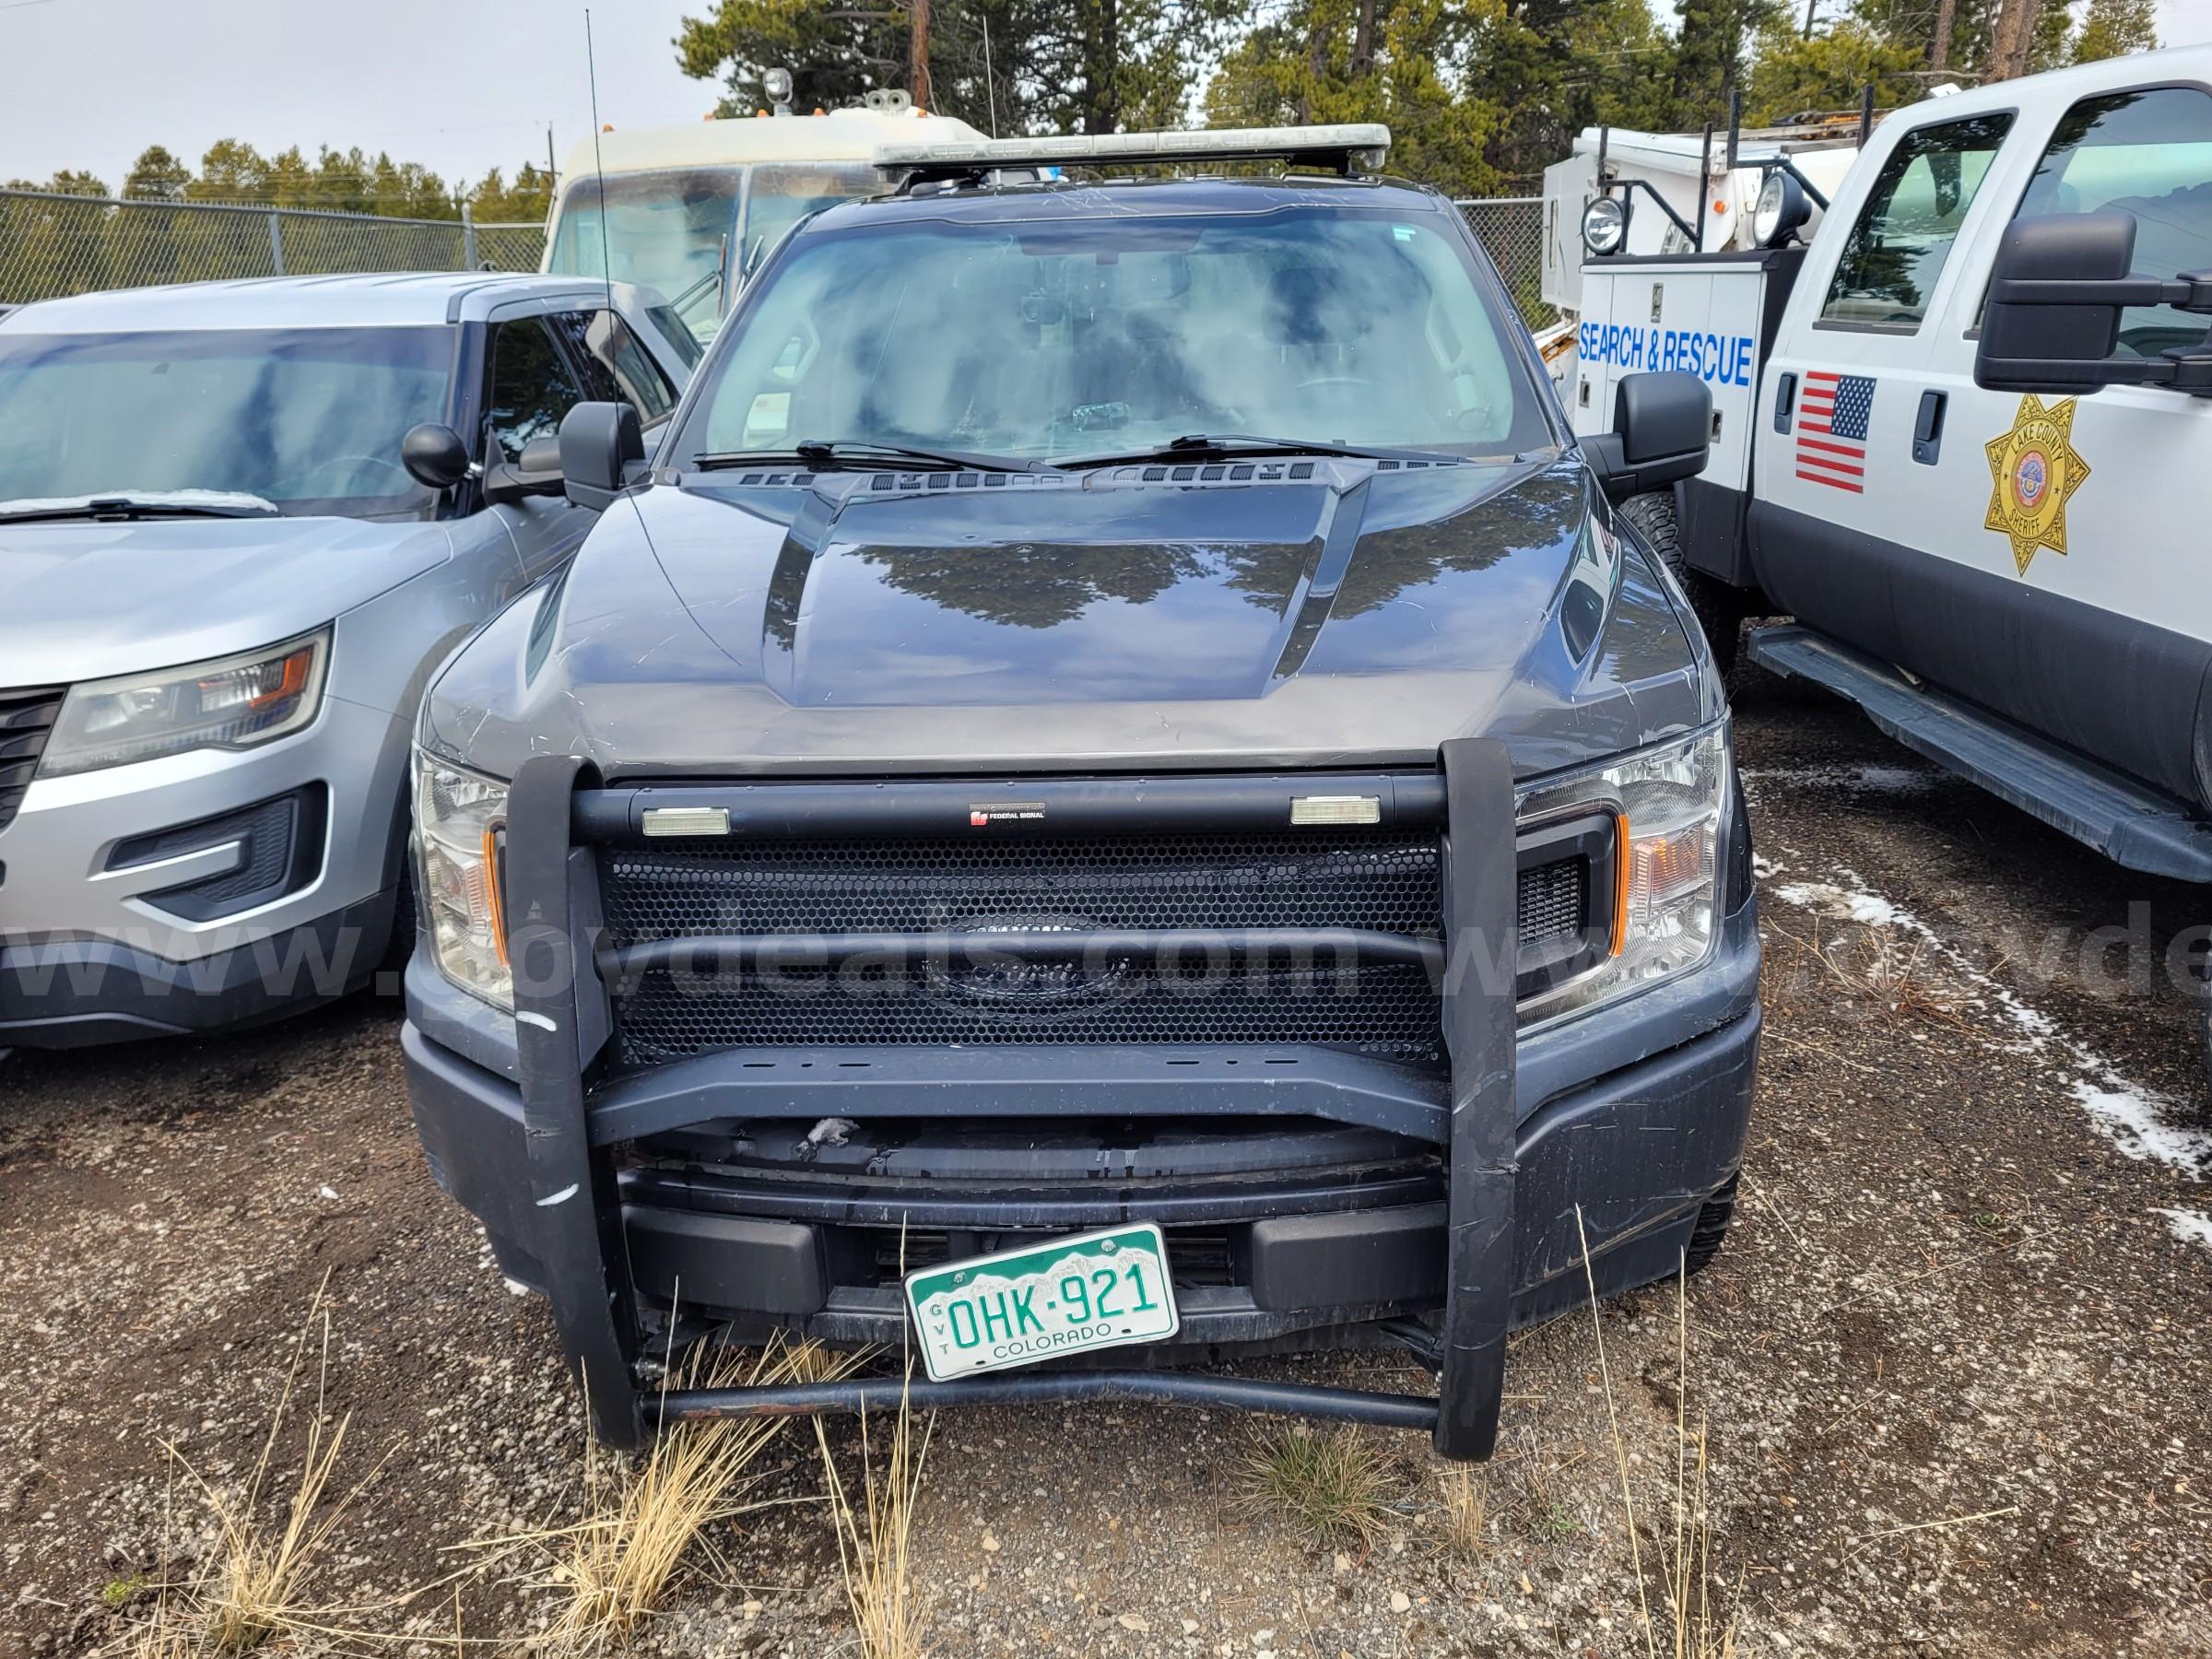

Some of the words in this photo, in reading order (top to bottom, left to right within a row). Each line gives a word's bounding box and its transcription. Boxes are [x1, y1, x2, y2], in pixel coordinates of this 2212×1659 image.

[1579, 322, 1645, 370] SEARCH
[1647, 328, 1660, 372] &
[1662, 329, 1754, 387] RESCUE
[2010, 423, 2035, 455] LAKE
[2036, 422, 2065, 463] COUNTY
[2008, 508, 2041, 535] SHERIFF
[1019, 811, 1045, 819] SIGNAL
[993, 1323, 1112, 1359] COLORADO
